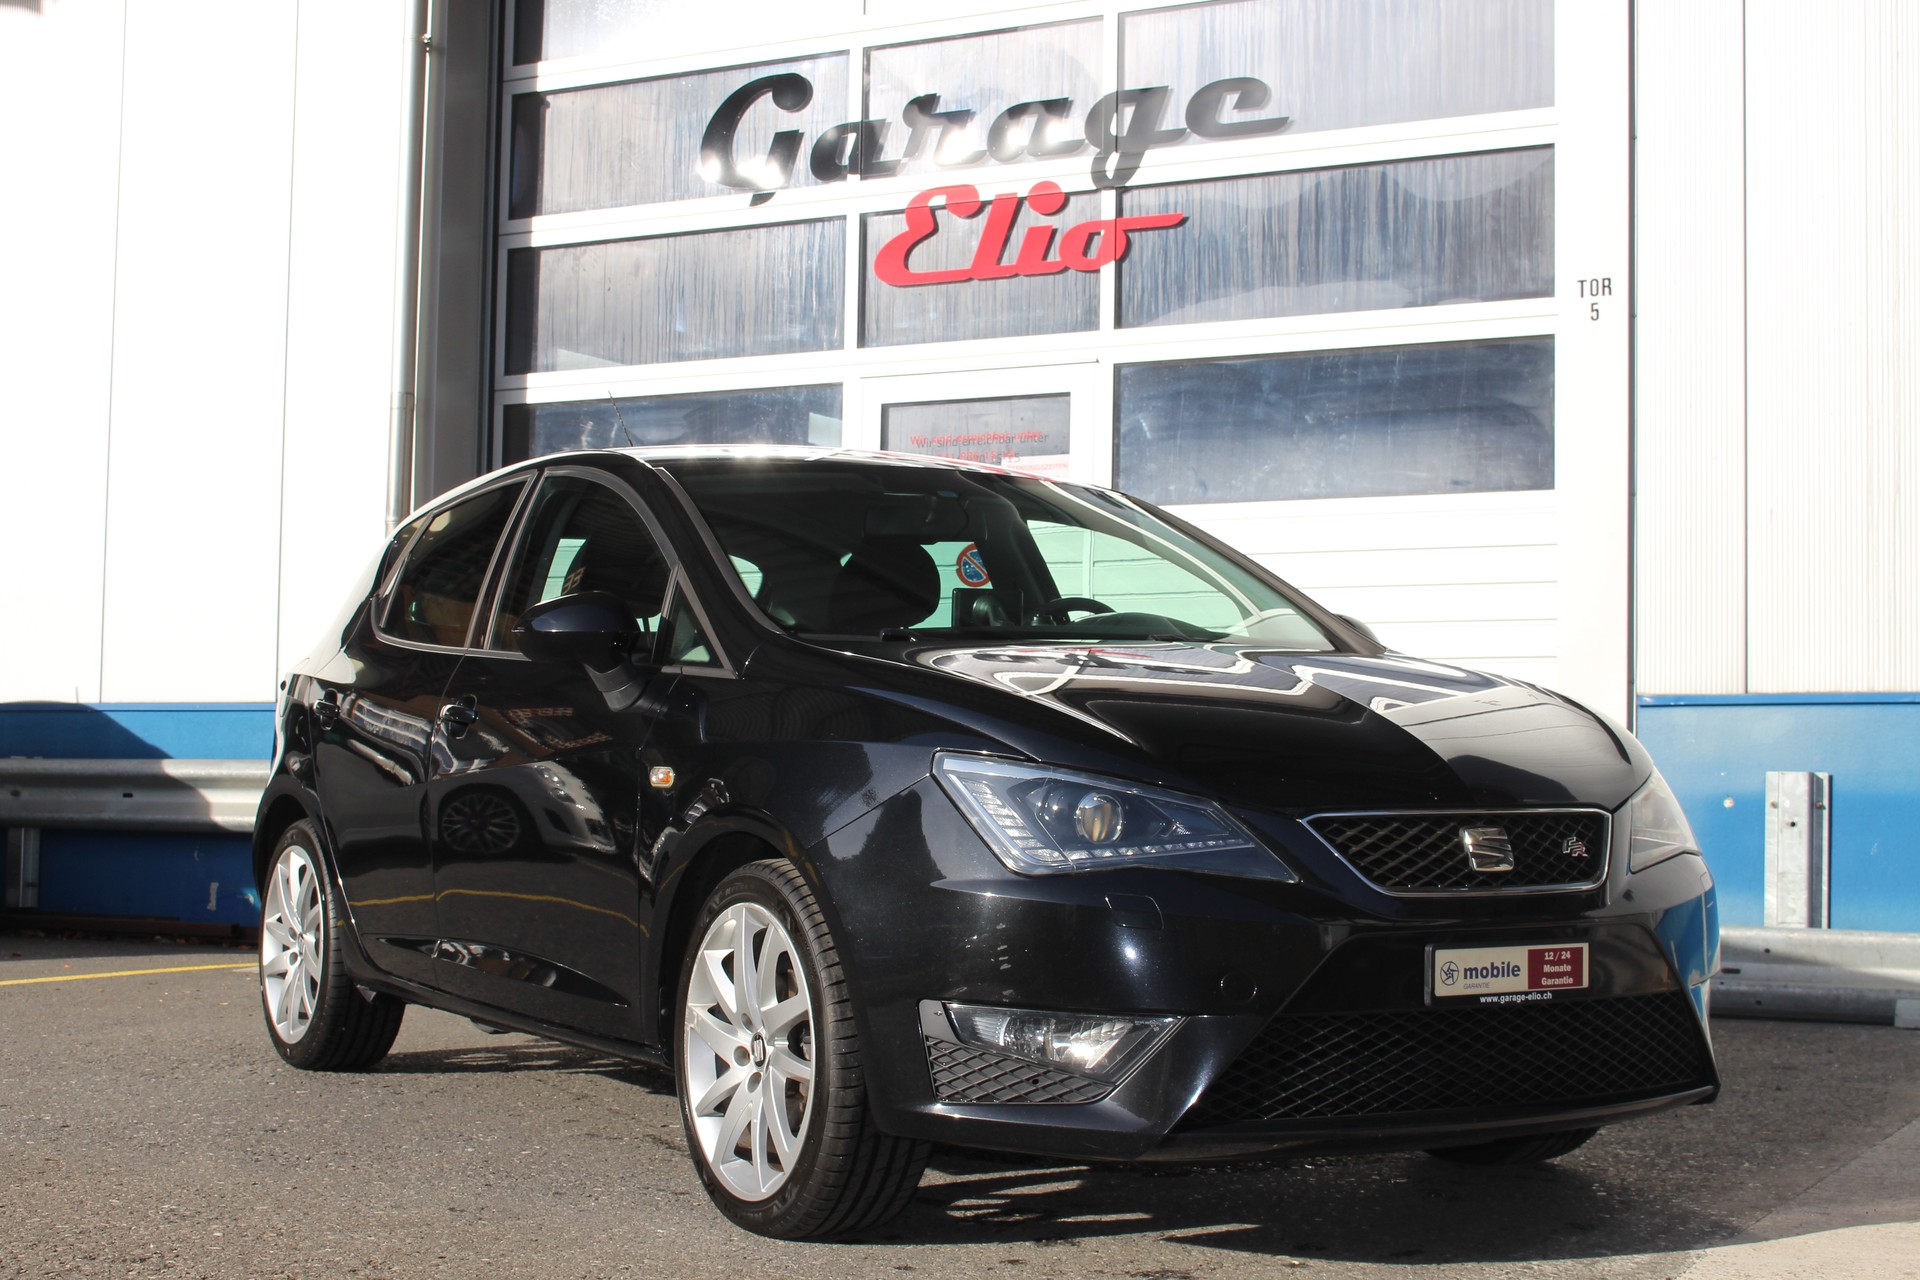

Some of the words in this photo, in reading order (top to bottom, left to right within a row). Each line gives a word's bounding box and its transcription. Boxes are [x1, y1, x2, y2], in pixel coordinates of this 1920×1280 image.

[701, 72, 1291, 206] Garage
[874, 180, 1187, 287] Elio
[1577, 277, 1612, 298] TOR
[1590, 302, 1600, 321] 5
[1544, 951, 1554, 960] 12
[1561, 950, 1571, 960] 24
[1463, 961, 1521, 980] mobile
[1543, 964, 1572, 973] Monate
[1463, 982, 1491, 990] GARANTIE
[1541, 976, 1574, 986] Garantie
[1479, 991, 1553, 1004] www.garage-elio.ch
